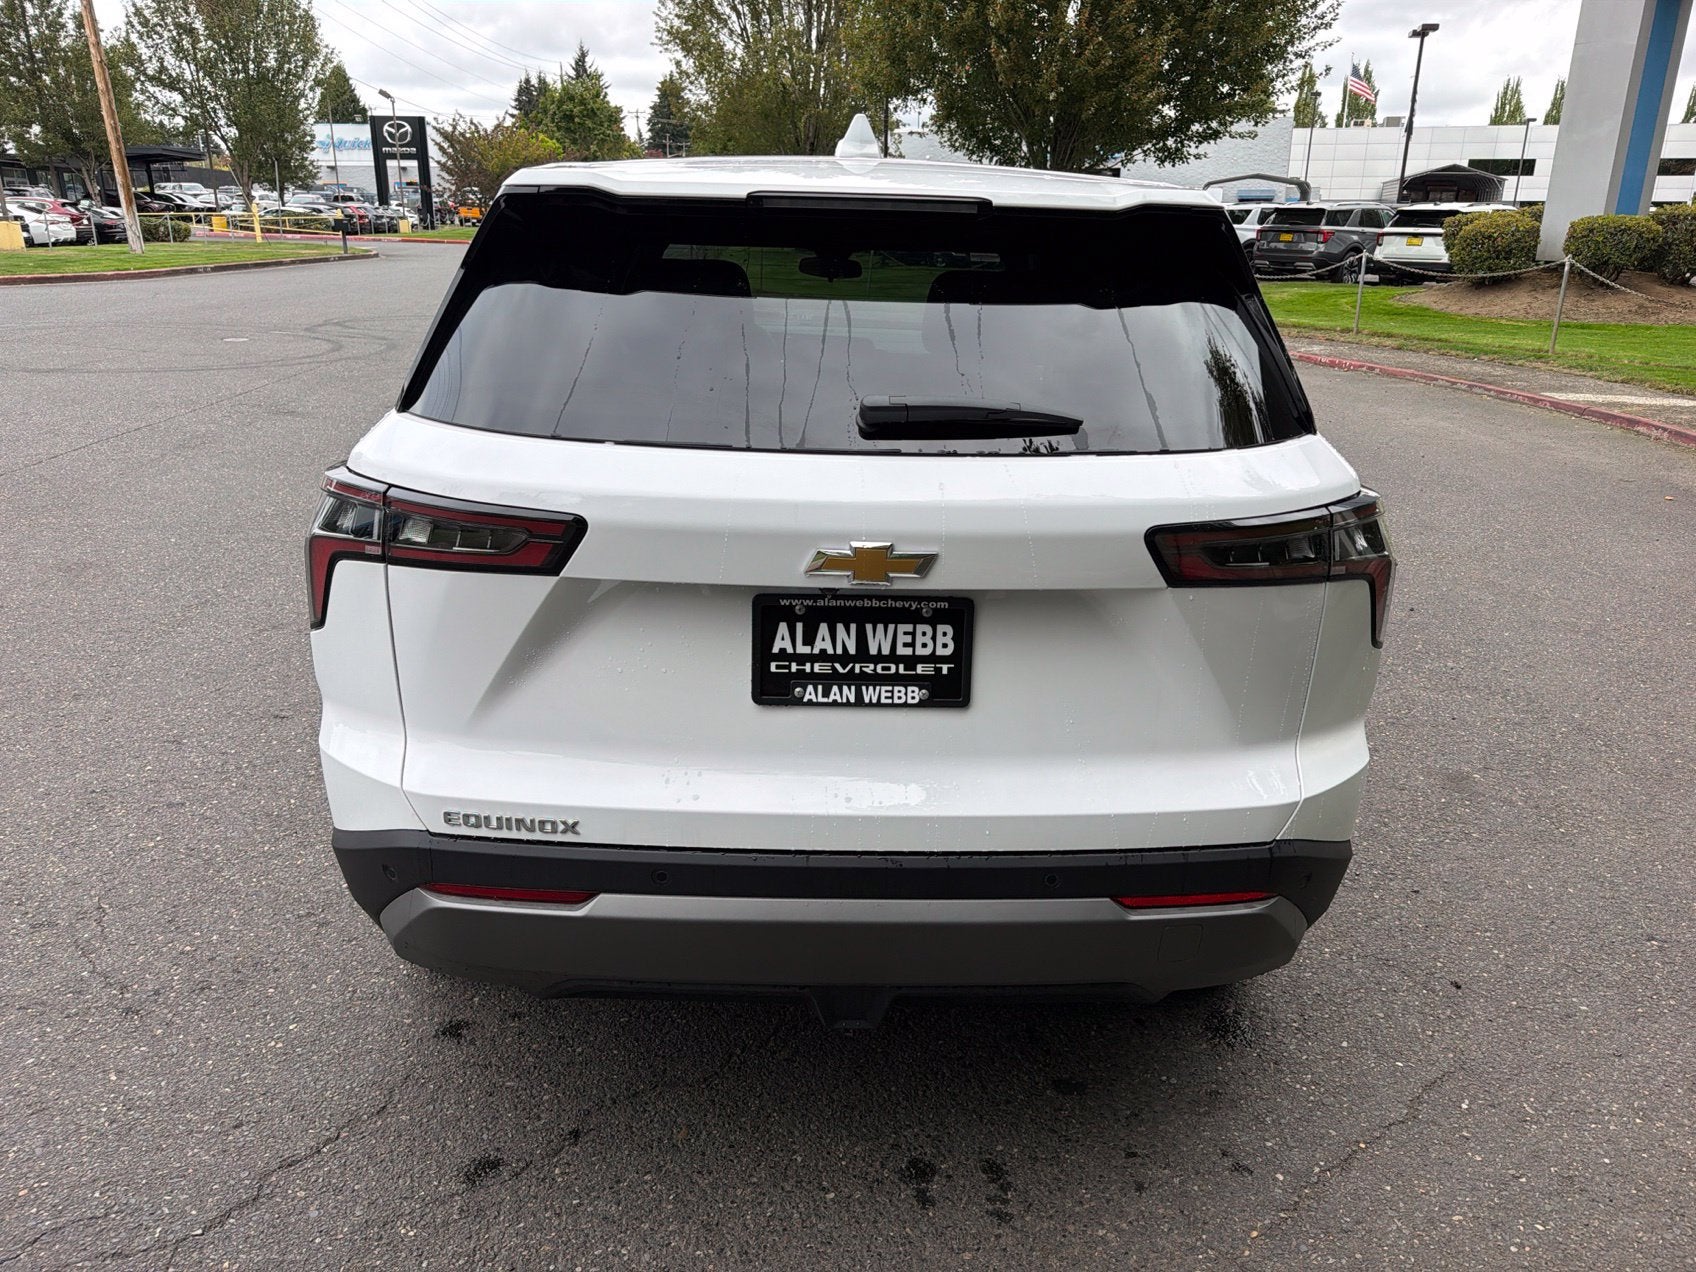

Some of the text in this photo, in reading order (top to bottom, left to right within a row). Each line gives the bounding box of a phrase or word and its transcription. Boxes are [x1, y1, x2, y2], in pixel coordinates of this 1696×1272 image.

[779, 597, 949, 609] www.alanwebbchevy.com
[771, 621, 955, 656] ALAN WEBB
[769, 661, 955, 675] CHEVROLET
[803, 684, 920, 704] ALAN WEBB
[443, 811, 581, 835] EQUINOX
